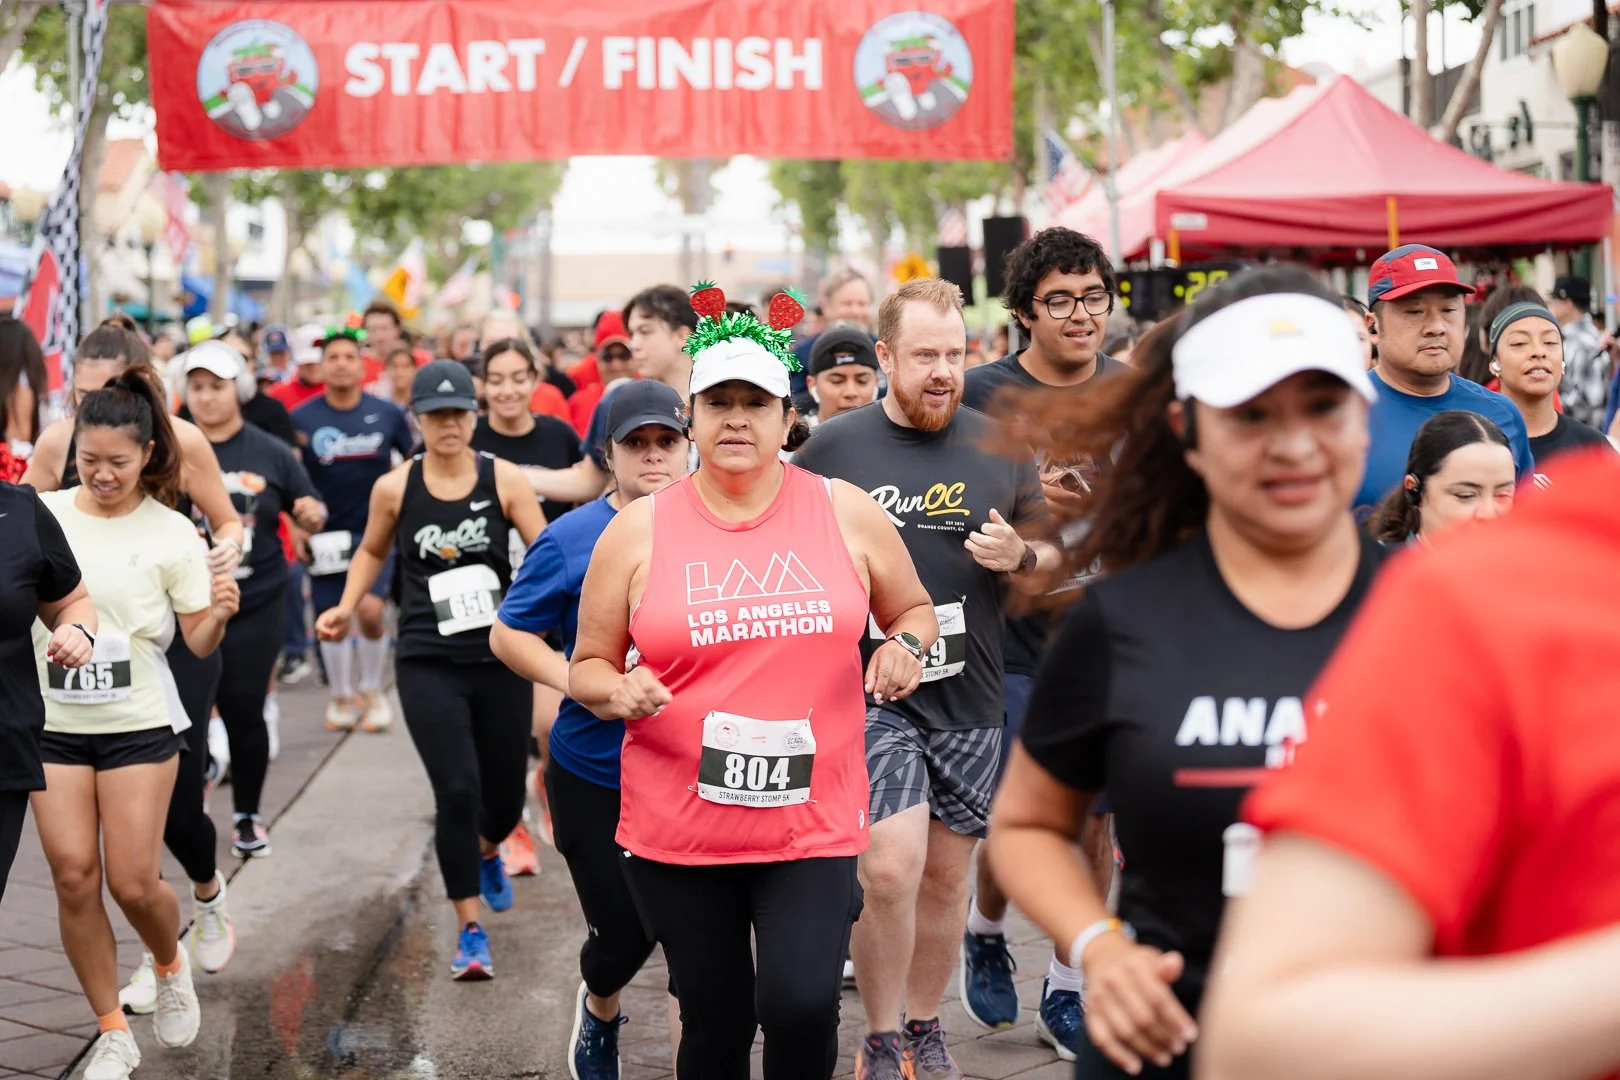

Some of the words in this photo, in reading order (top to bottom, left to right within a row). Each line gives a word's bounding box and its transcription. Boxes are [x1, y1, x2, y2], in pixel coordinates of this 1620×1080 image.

[344, 38, 546, 98] START
[558, 36, 588, 88] /
[602, 36, 823, 91] FINISH
[868, 482, 966, 528] RunOC
[448, 589, 494, 620] 650
[687, 609, 729, 629] LOS
[737, 599, 832, 622] ANGELES
[689, 615, 834, 648] MARATHON
[63, 661, 114, 691] 765
[723, 753, 791, 791] 804
[719, 791, 760, 803] STRAWBERRY
[761, 795, 781, 803] STOMP
